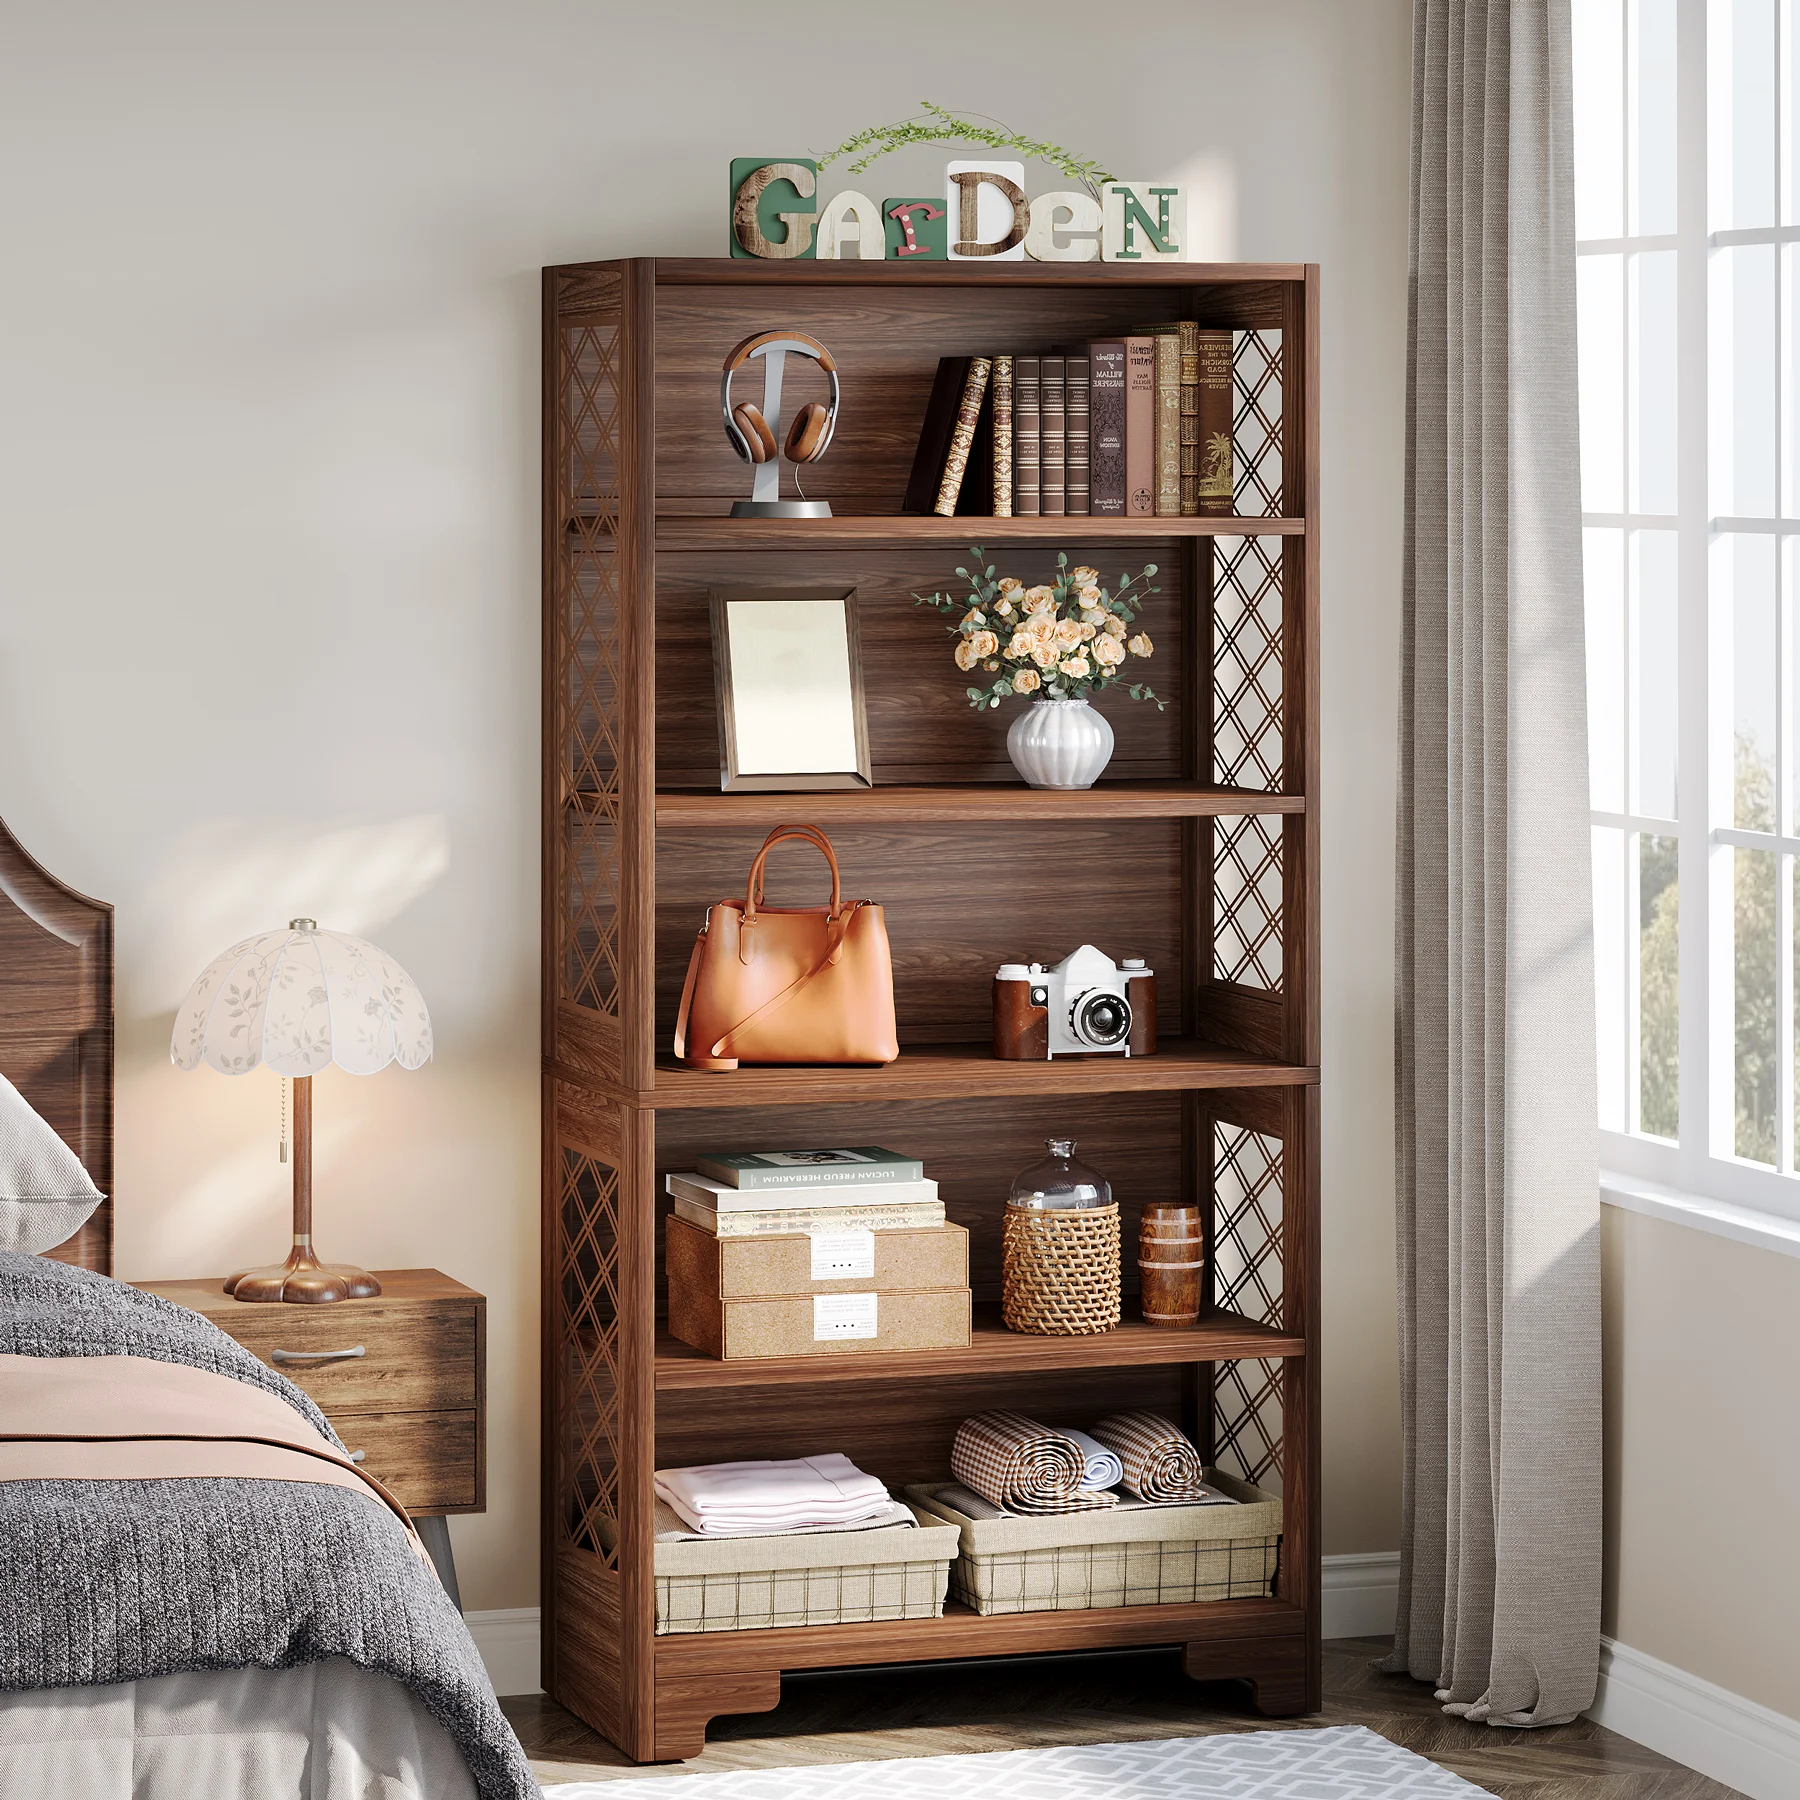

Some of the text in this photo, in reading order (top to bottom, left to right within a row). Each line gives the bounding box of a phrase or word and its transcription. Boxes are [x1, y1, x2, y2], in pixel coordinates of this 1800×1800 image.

[762, 1174, 821, 1183] HERBARIUM
[823, 1173, 856, 1181] FREUD
[859, 1170, 895, 1179] LUCIAN
